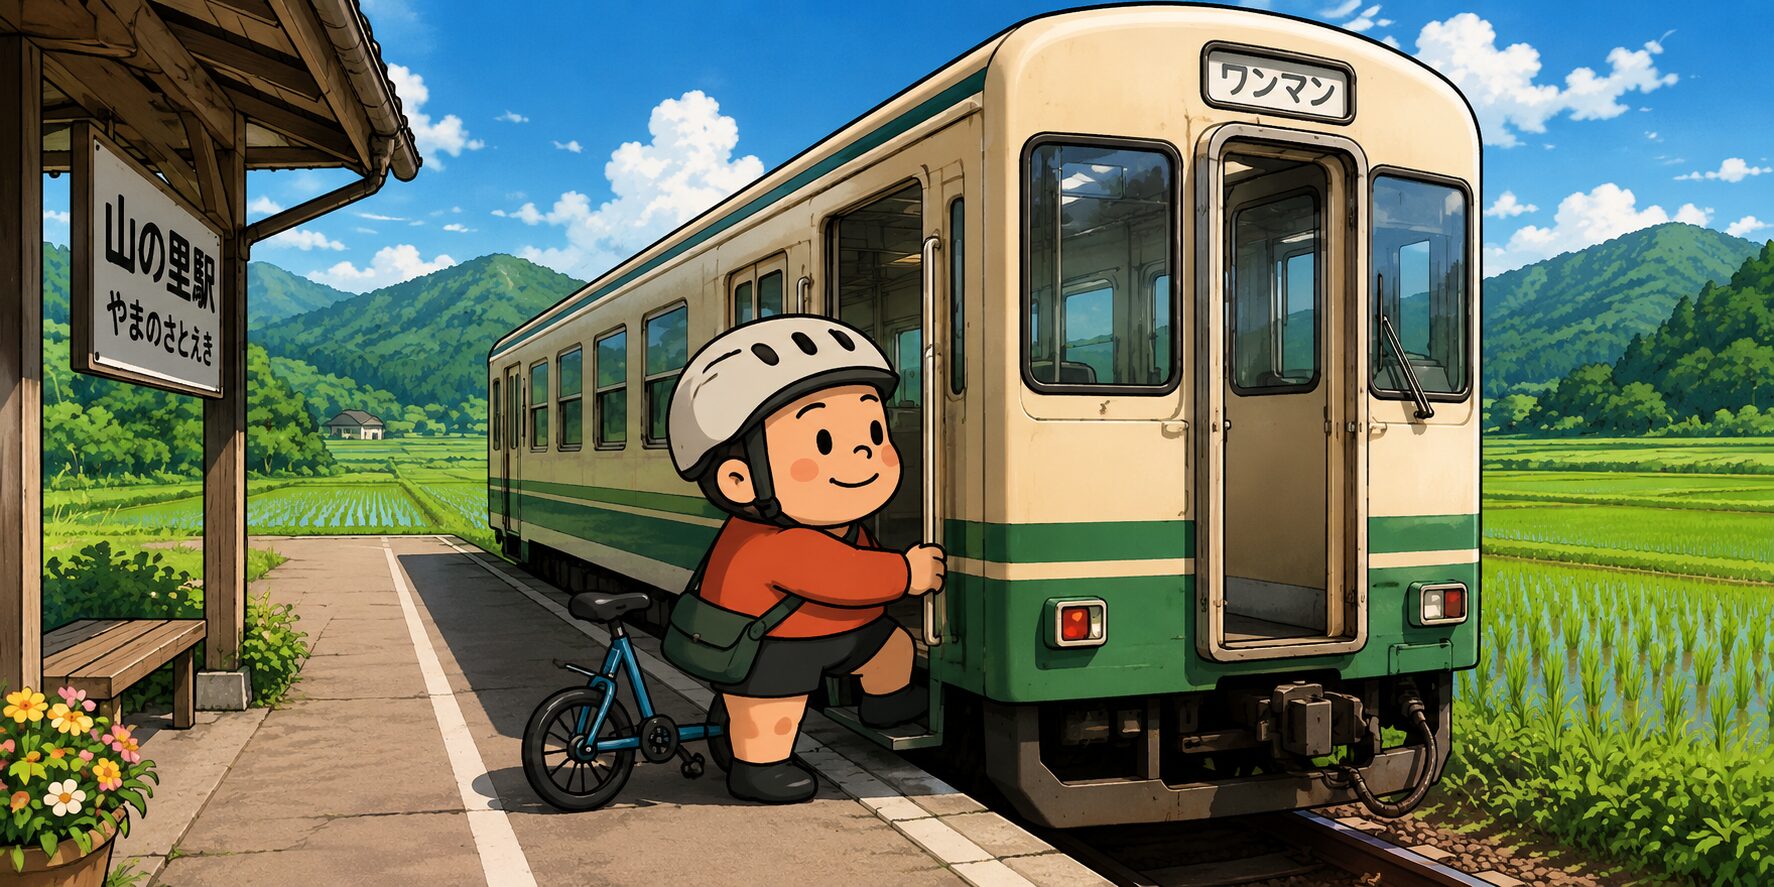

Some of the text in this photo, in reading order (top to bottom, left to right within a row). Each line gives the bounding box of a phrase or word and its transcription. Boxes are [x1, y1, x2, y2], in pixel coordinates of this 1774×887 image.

[1222, 63, 1335, 106] ワンマン
[105, 194, 215, 314] 山の里駅
[107, 290, 213, 367] やまのさとえき
